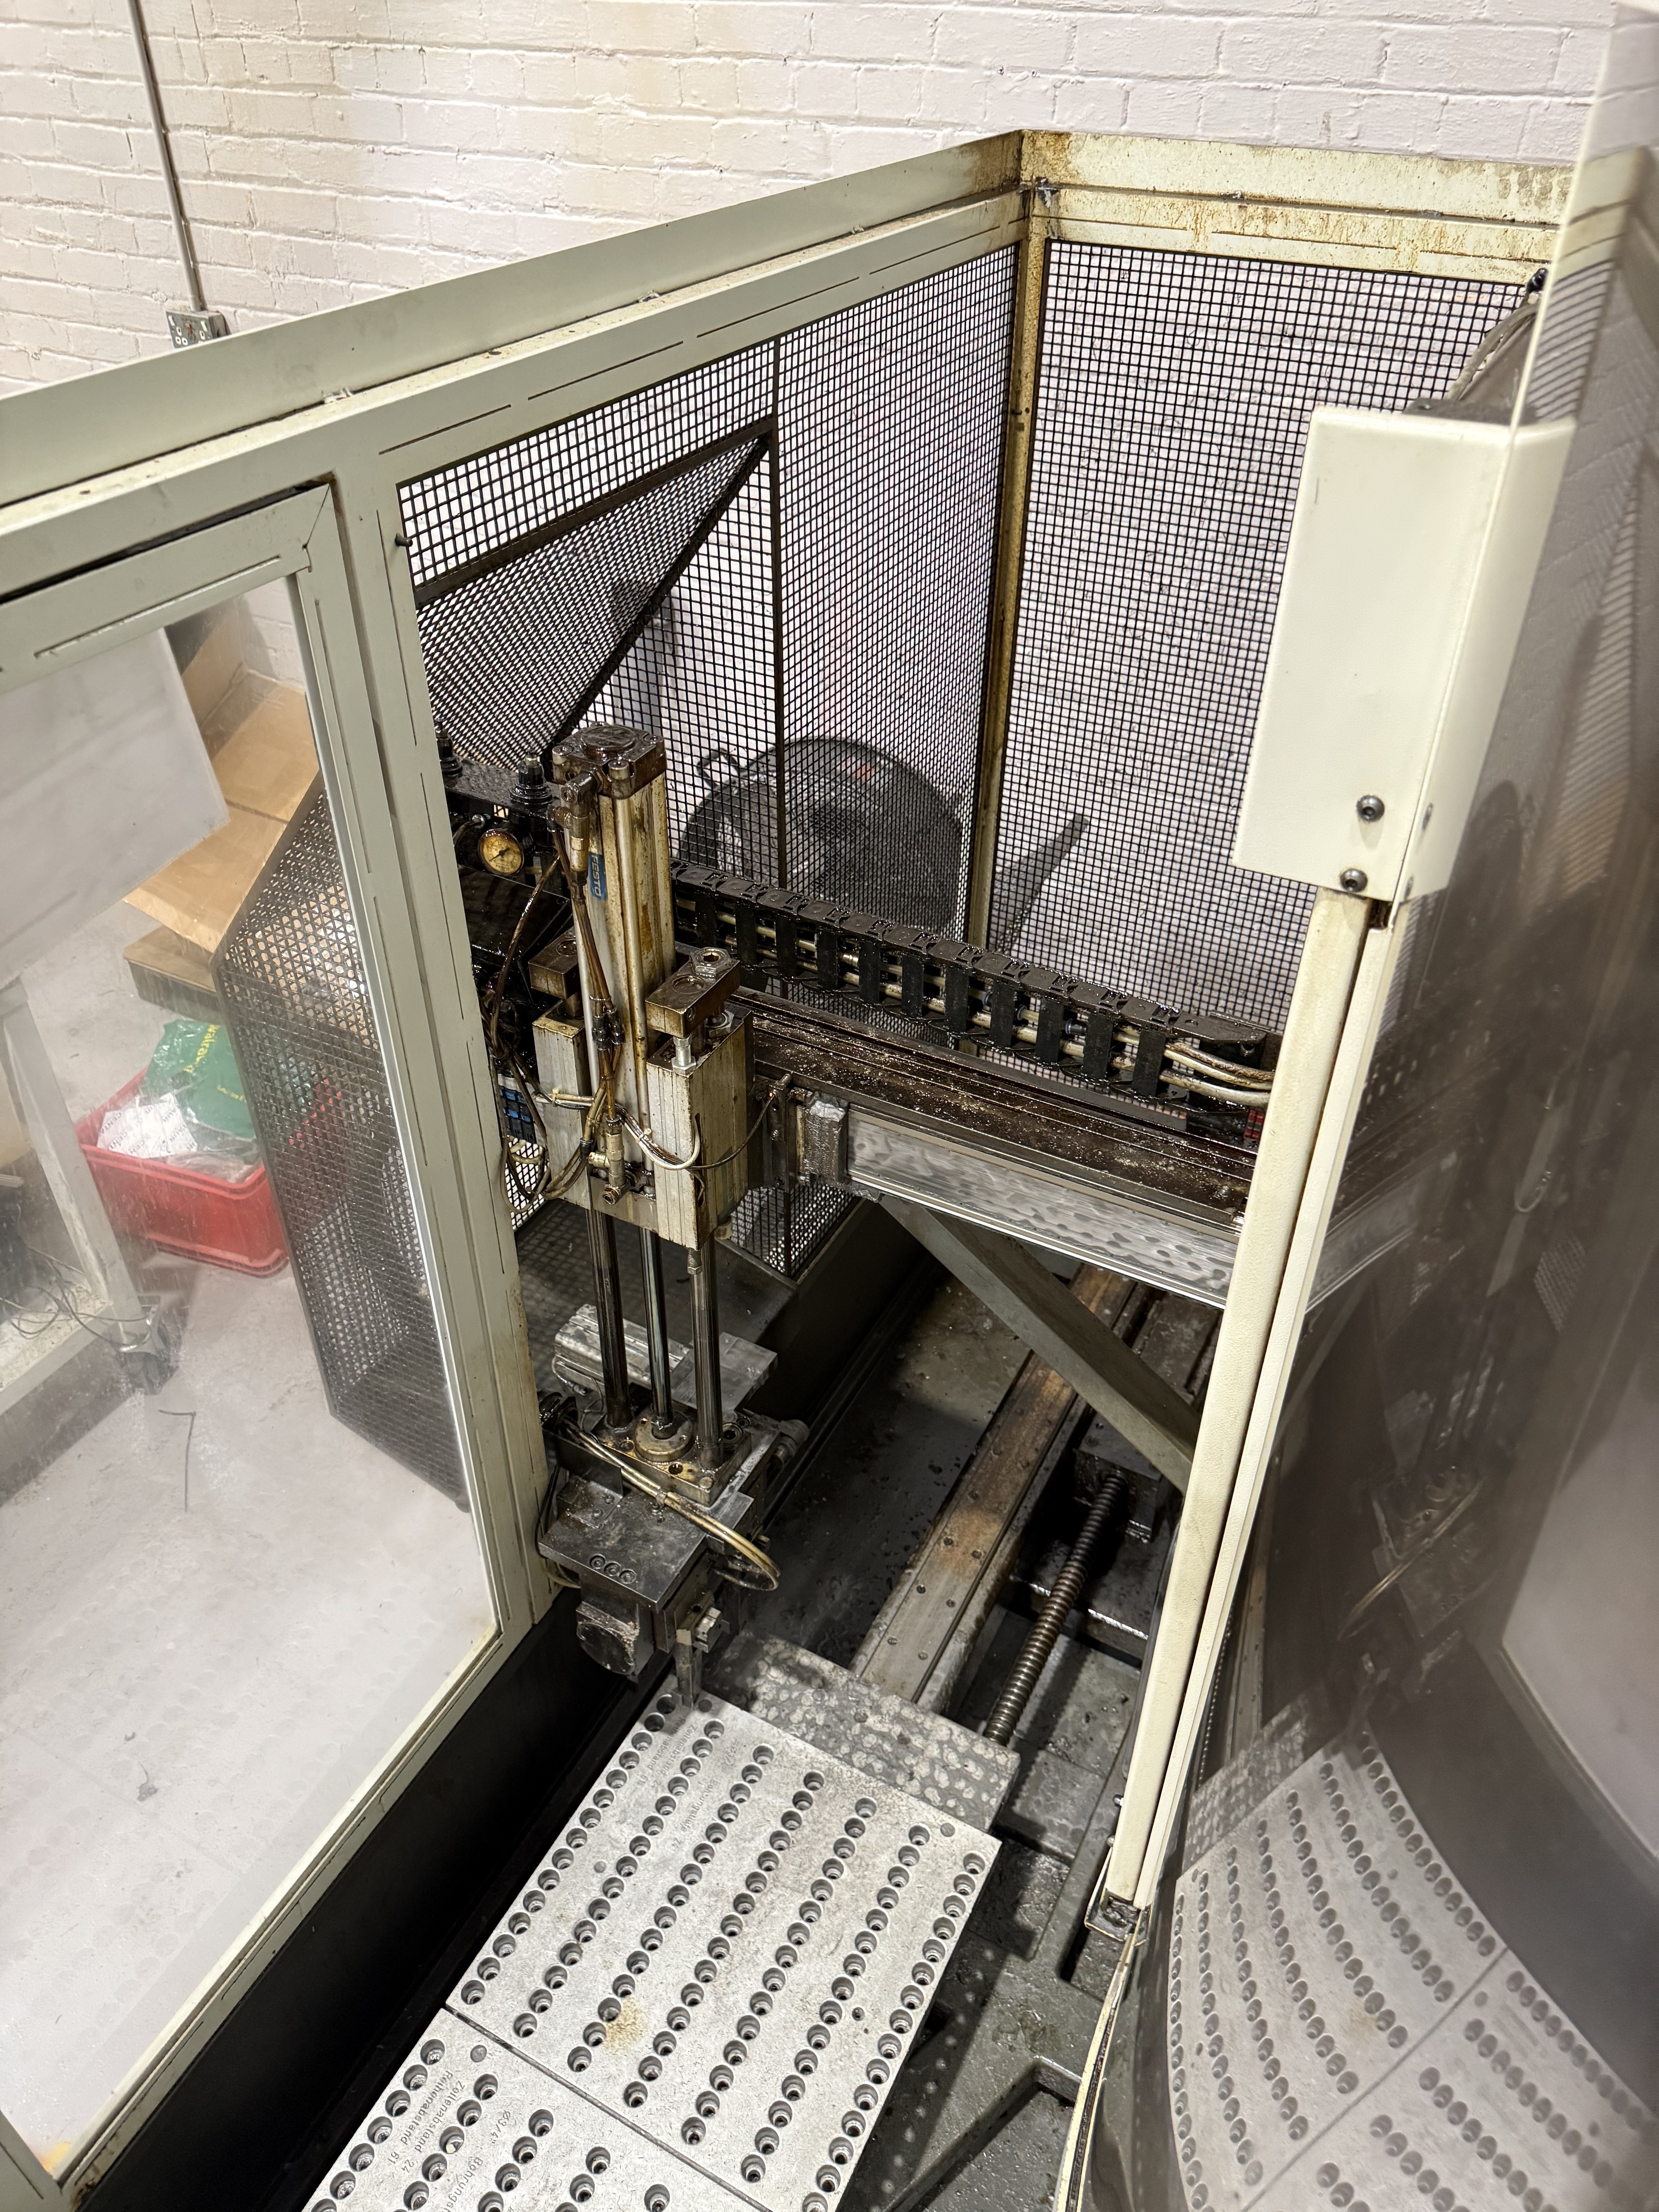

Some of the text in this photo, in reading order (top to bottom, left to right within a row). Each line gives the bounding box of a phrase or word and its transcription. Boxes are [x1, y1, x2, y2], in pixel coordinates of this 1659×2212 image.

[591, 855, 601, 896] FESTO
[647, 1717, 686, 1771] Reihenabstand
[661, 1724, 697, 1776] Zeilenabstand
[388, 2070, 453, 2164] Reihenabstand 61
[401, 2080, 465, 2173] Zeilenabstand 24
